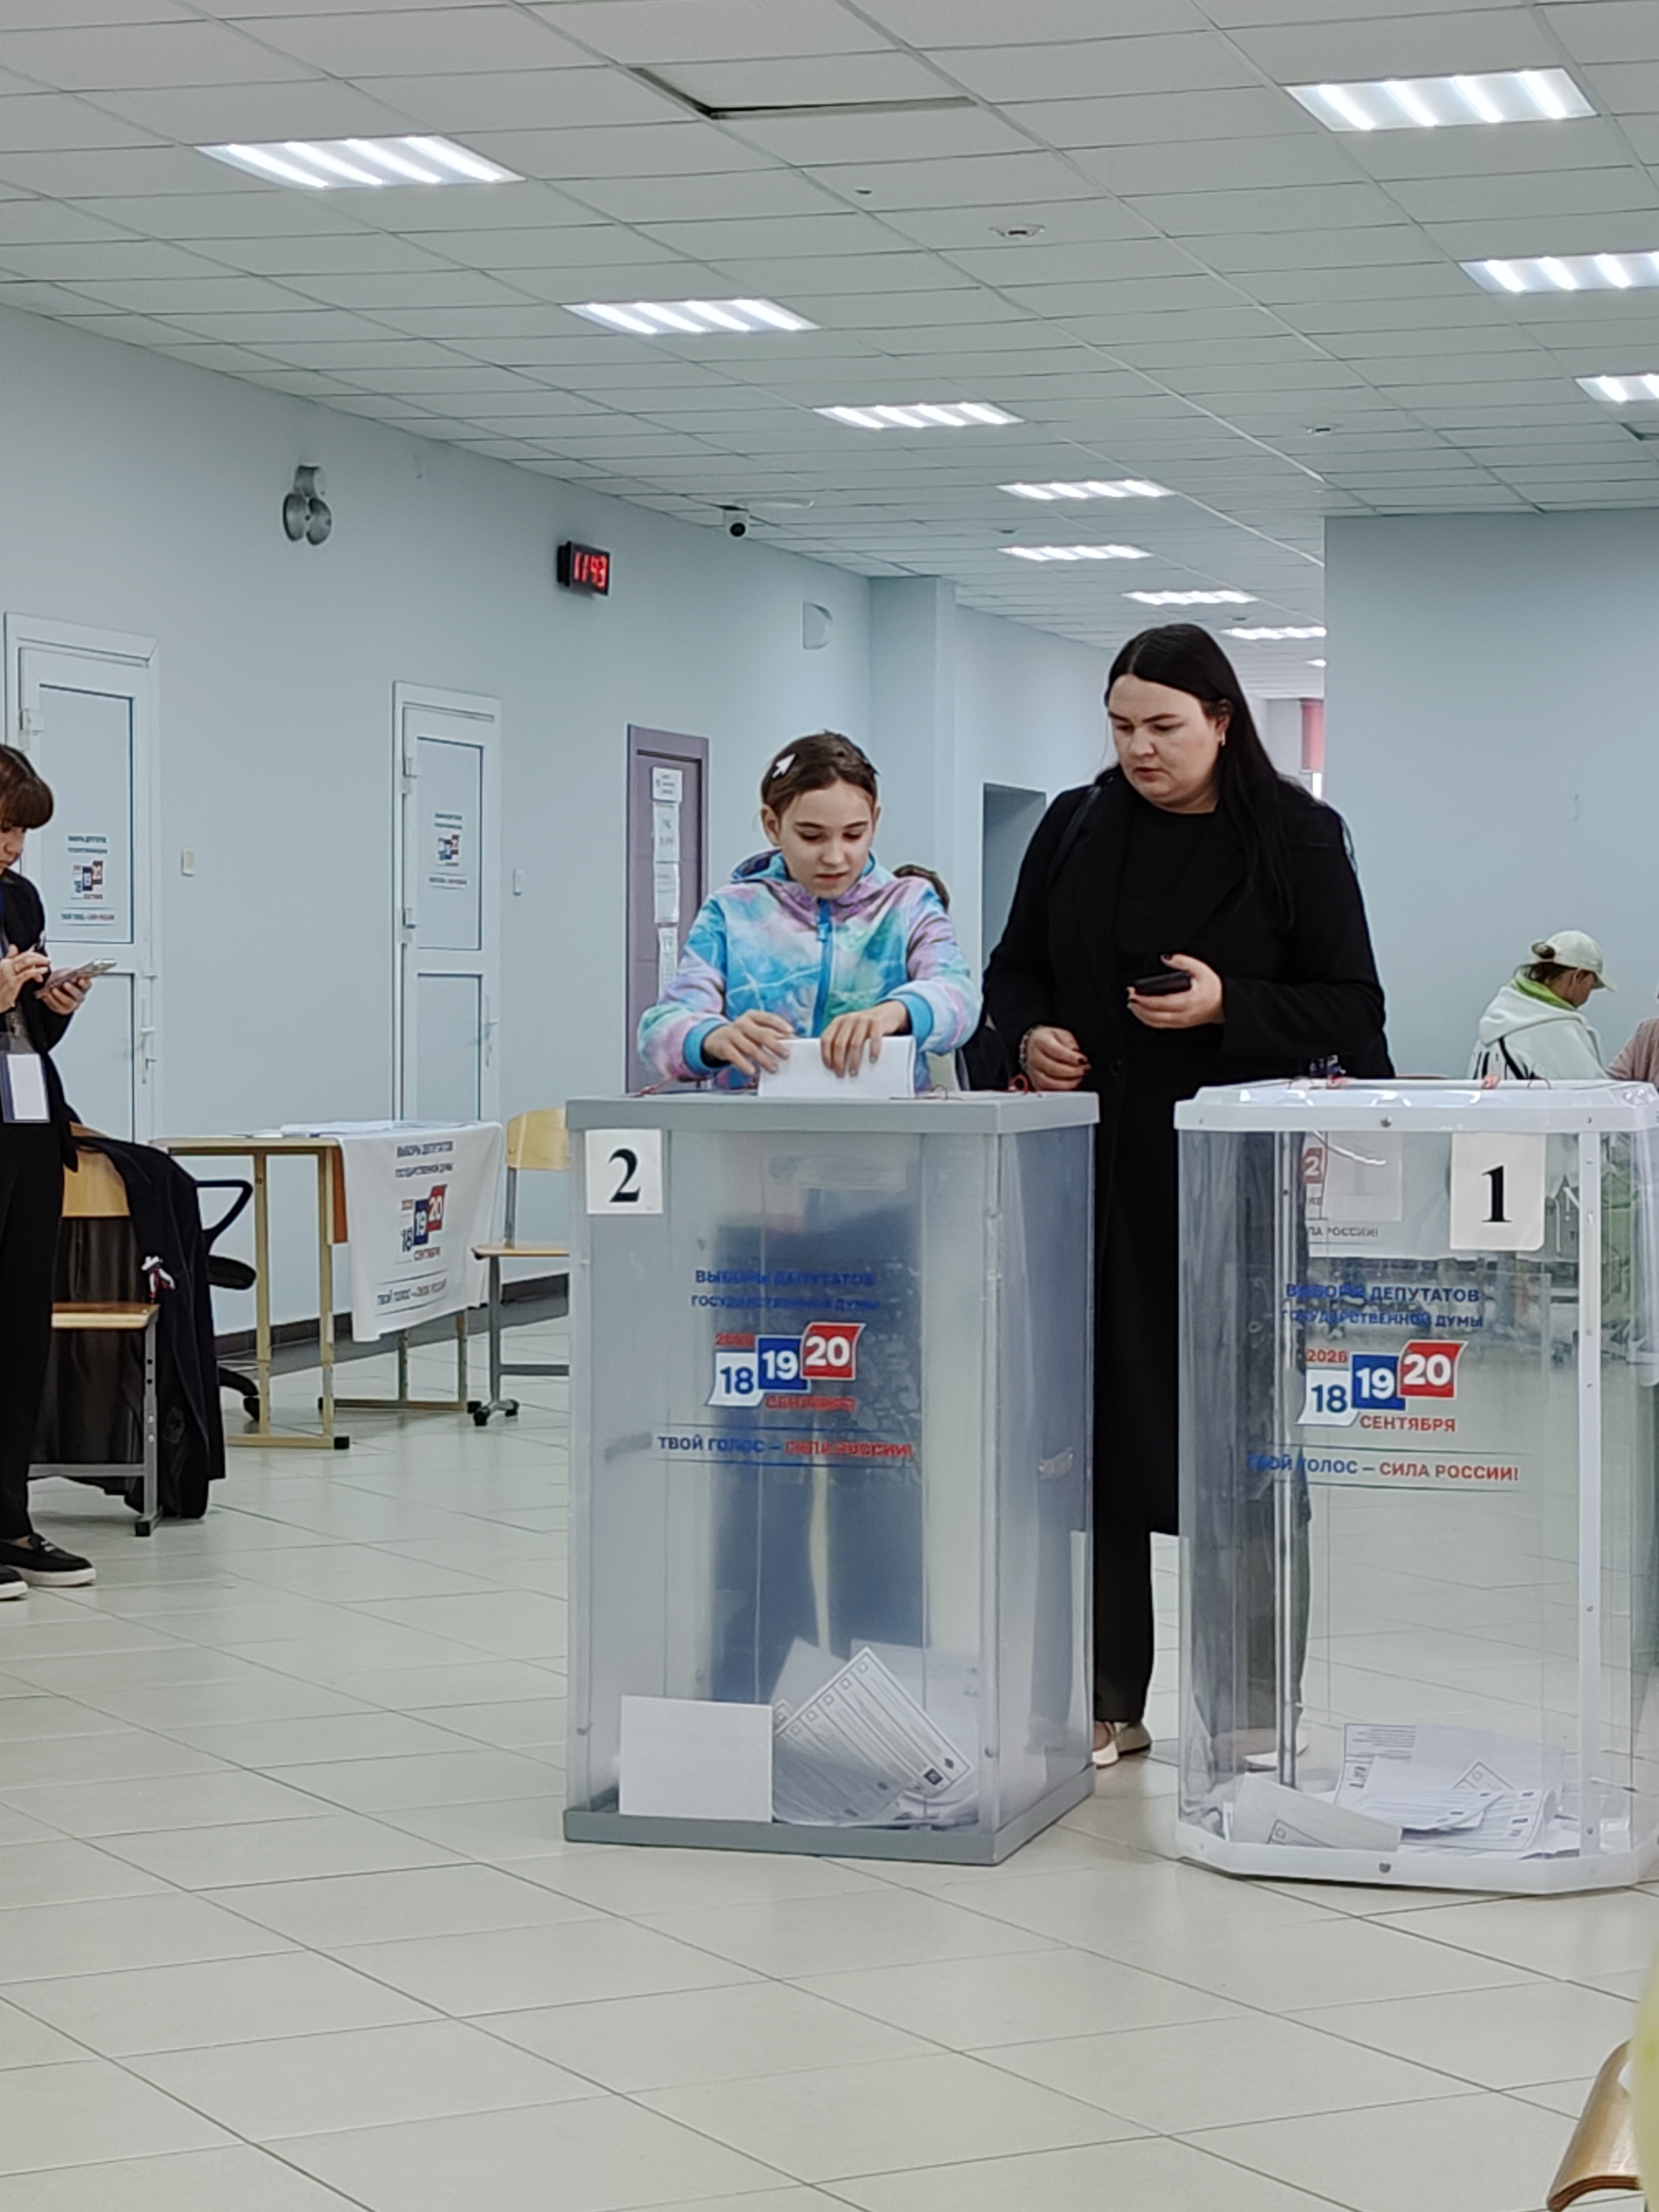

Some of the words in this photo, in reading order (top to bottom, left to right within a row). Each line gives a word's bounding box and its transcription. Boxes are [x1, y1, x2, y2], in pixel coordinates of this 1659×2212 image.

[609, 1148, 642, 1203] 2
[428, 1196, 442, 1220] 20
[1481, 1165, 1513, 1223] 1
[1371, 1286, 1480, 1303] ДЕПУТАТОВ
[1435, 1314, 1483, 1328] ДУМЫ
[761, 1350, 799, 1381] 19
[805, 1336, 850, 1367] 20
[720, 1366, 754, 1395] 18
[1355, 1367, 1394, 1400] 19
[1403, 1353, 1452, 1386] 20
[1311, 1384, 1347, 1413] 18
[1359, 1414, 1456, 1433] СЕНТЯБРЯ
[658, 1434, 704, 1450] ТВОЙ
[1379, 1461, 1430, 1479] СИЛА
[1435, 1464, 1519, 1482] РОССИИ!
